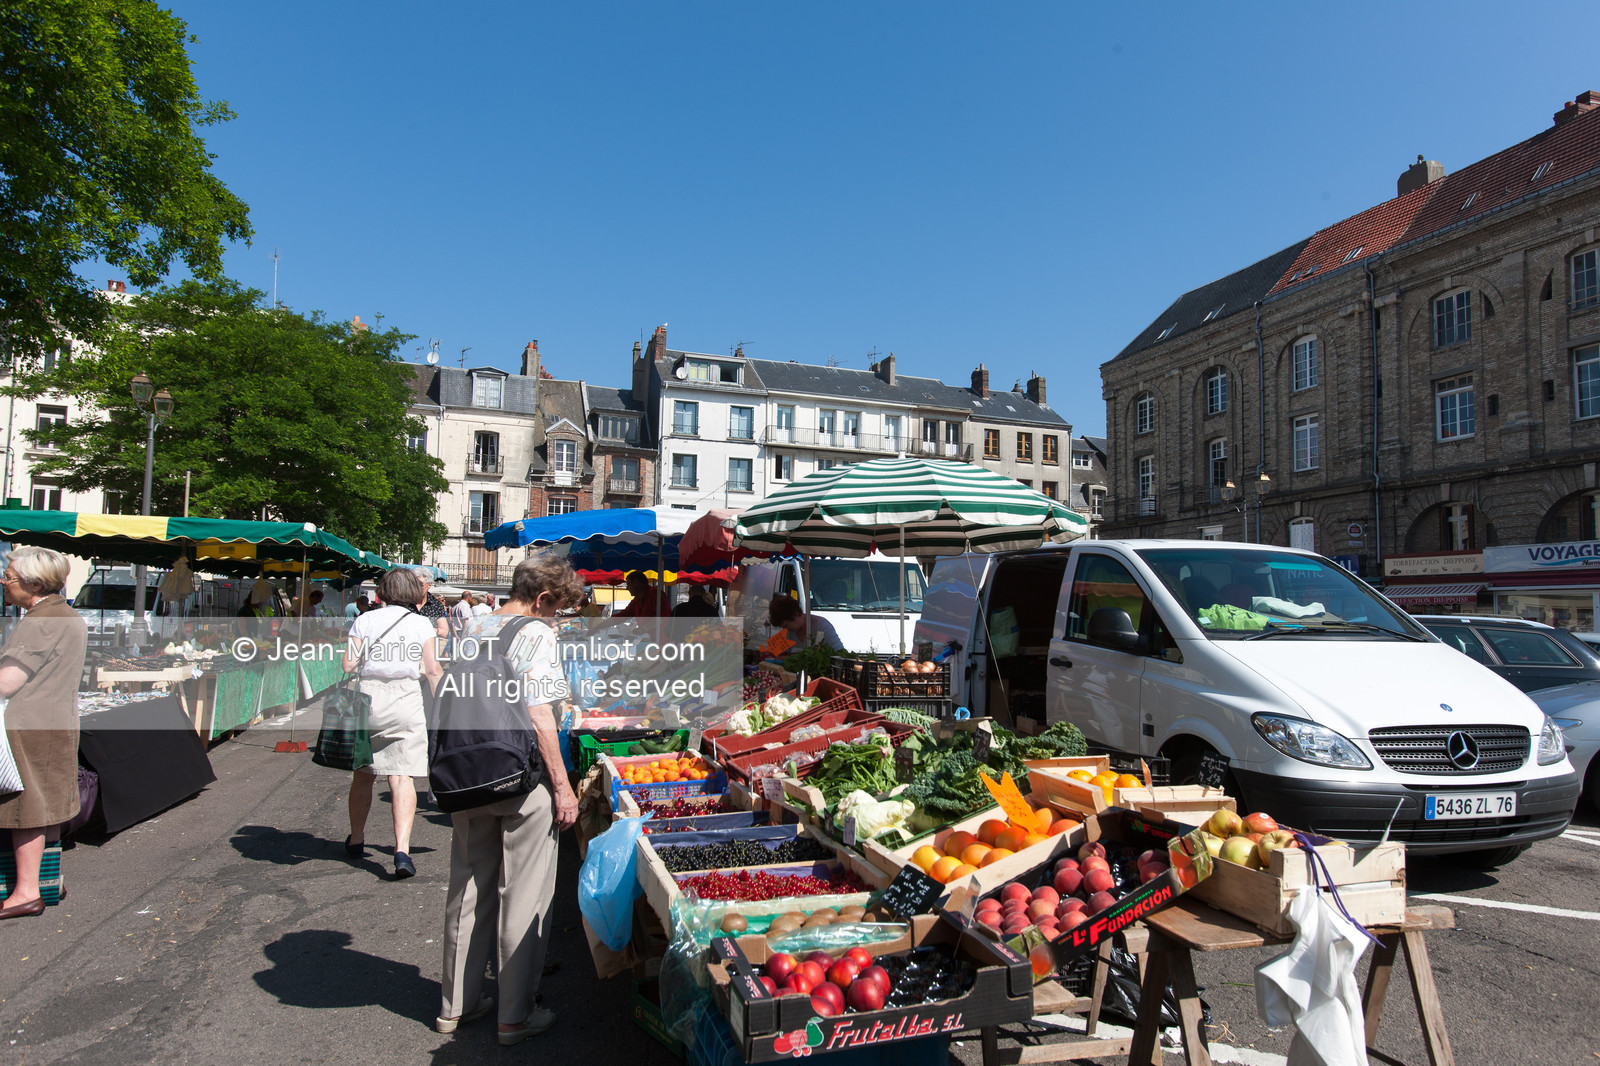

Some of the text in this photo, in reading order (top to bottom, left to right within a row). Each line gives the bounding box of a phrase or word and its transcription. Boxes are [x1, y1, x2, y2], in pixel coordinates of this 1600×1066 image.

[1436, 796, 1513, 815] 5436 ZL 76
